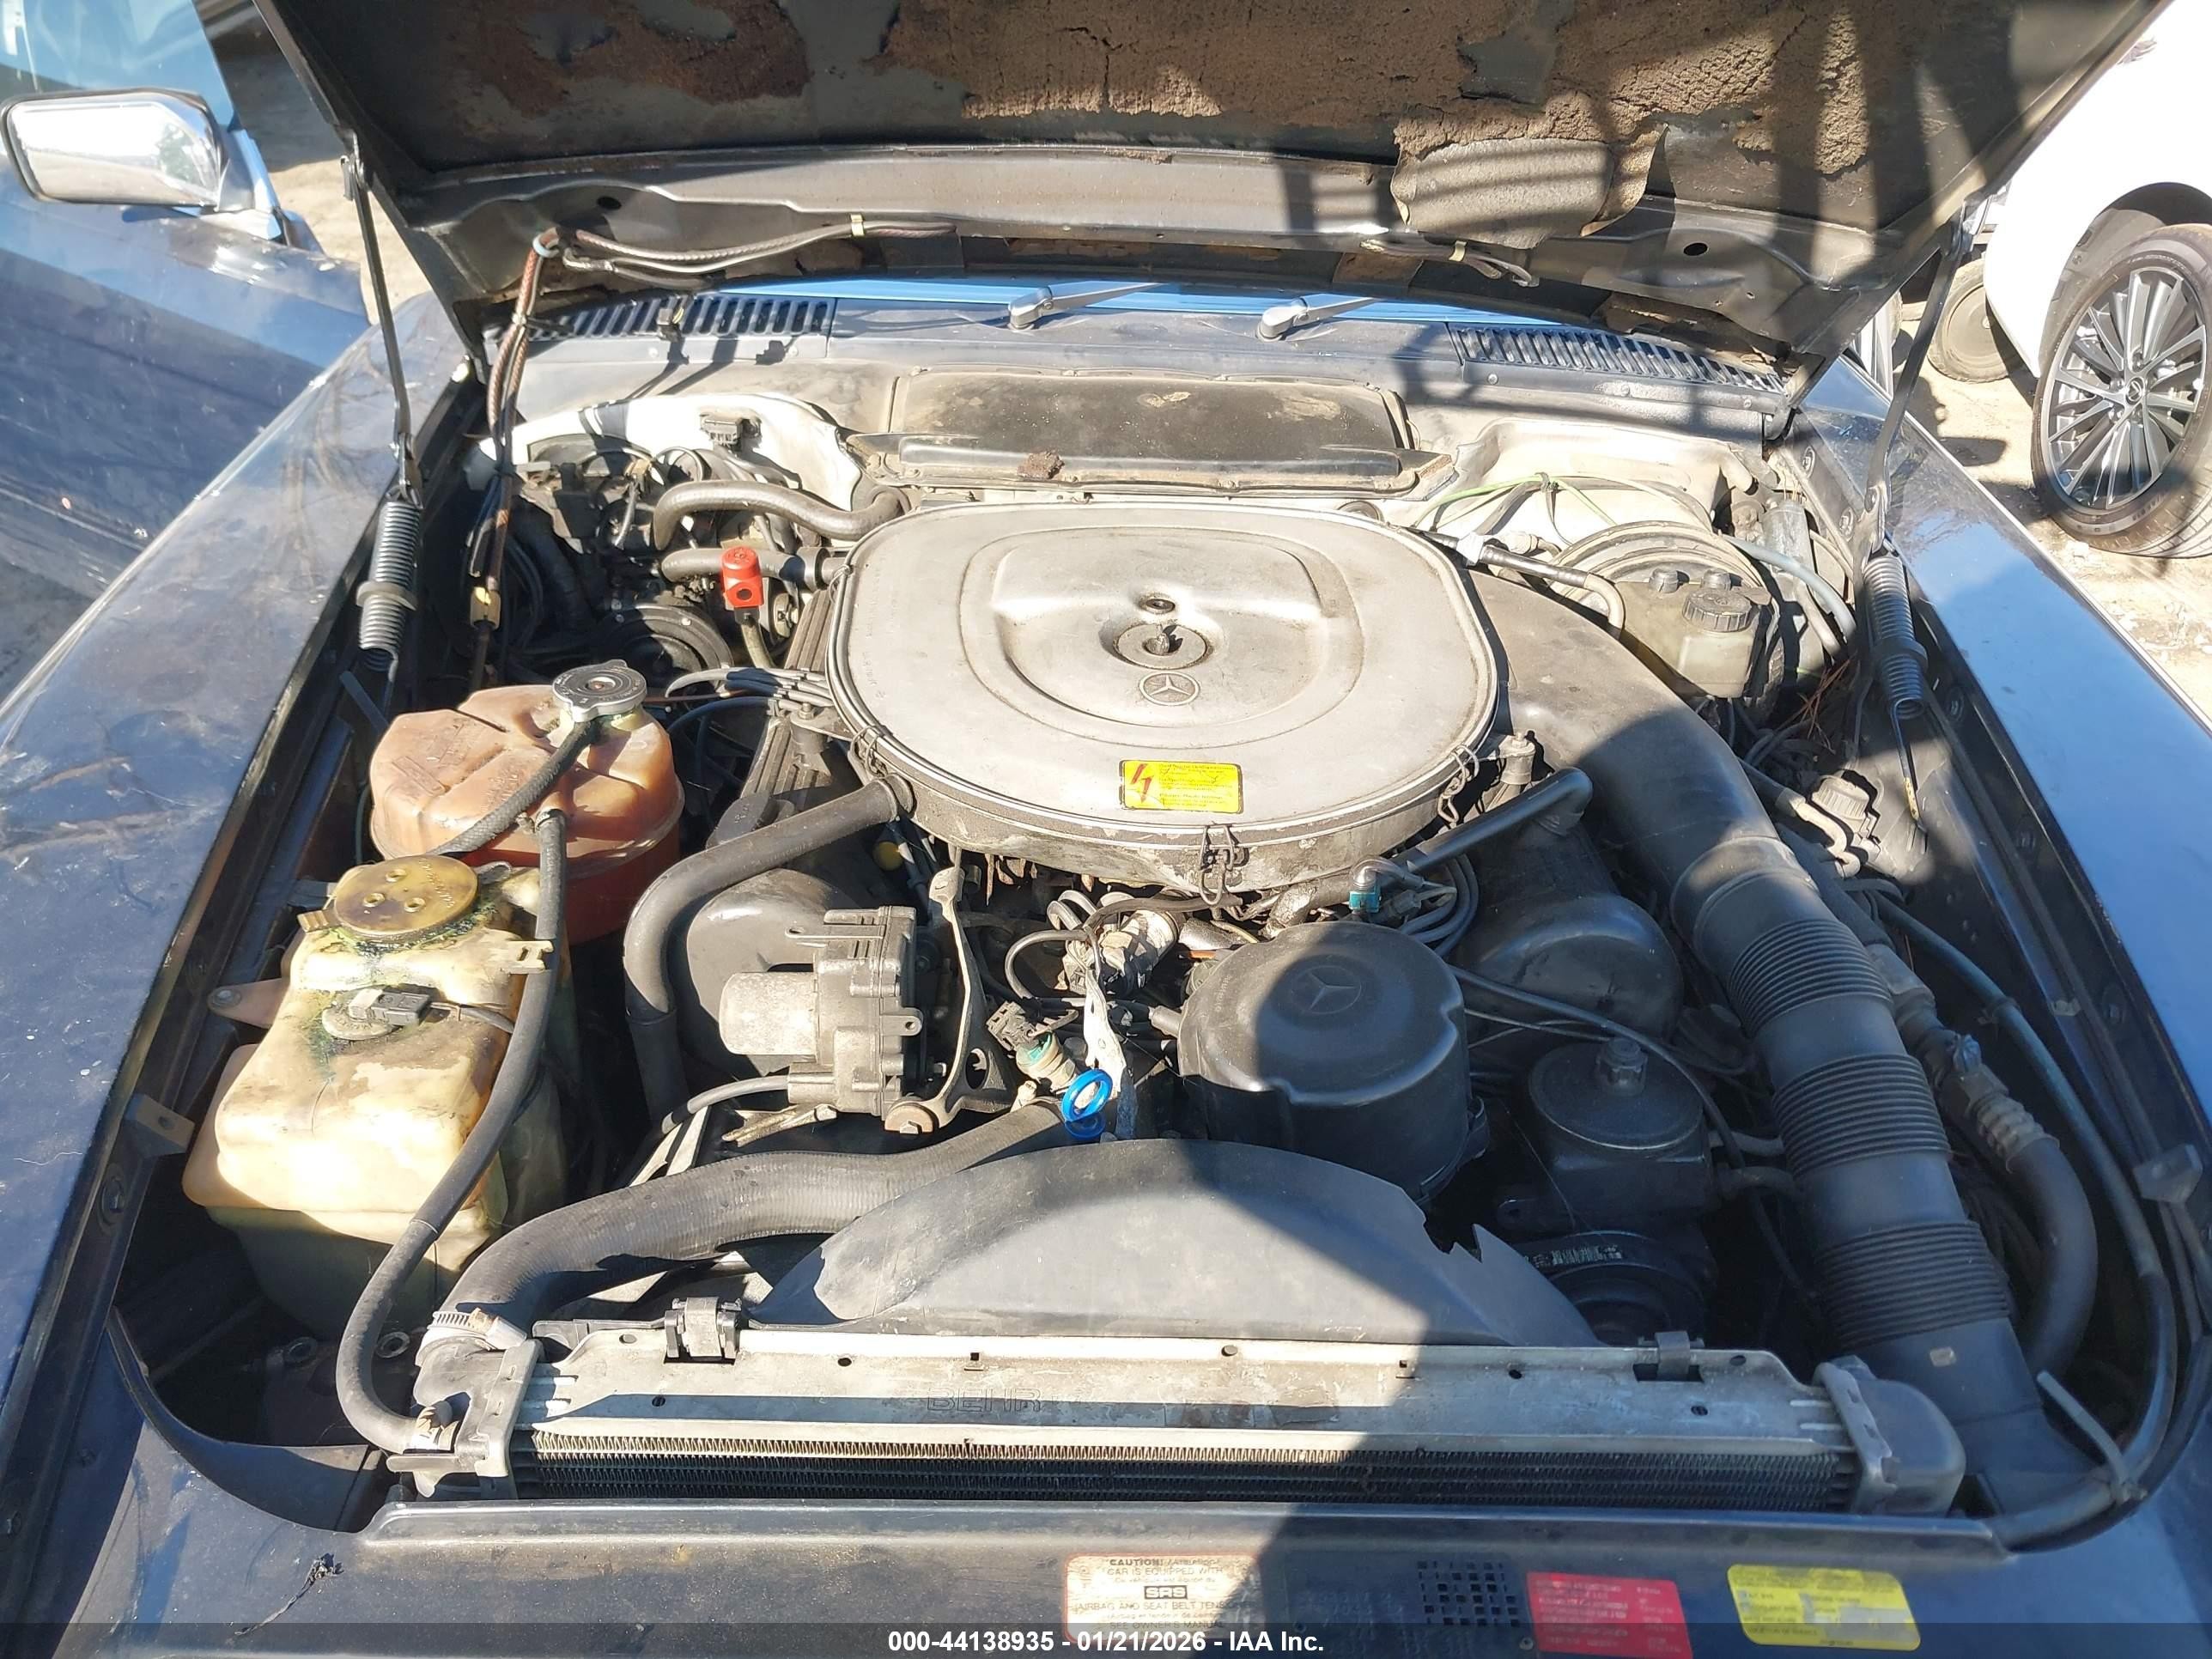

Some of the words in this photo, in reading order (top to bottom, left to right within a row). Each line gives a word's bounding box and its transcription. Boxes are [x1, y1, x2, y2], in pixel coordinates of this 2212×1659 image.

[927, 1387, 1042, 1413] BEHR
[1107, 1567, 1128, 1576] CAR
[1133, 1567, 1141, 1576] IS
[1145, 1586, 1187, 1599] SRS
[1119, 1601, 1139, 1610] AND
[1143, 1601, 1168, 1610] SEAT
[1172, 1601, 1196, 1609] BELT
